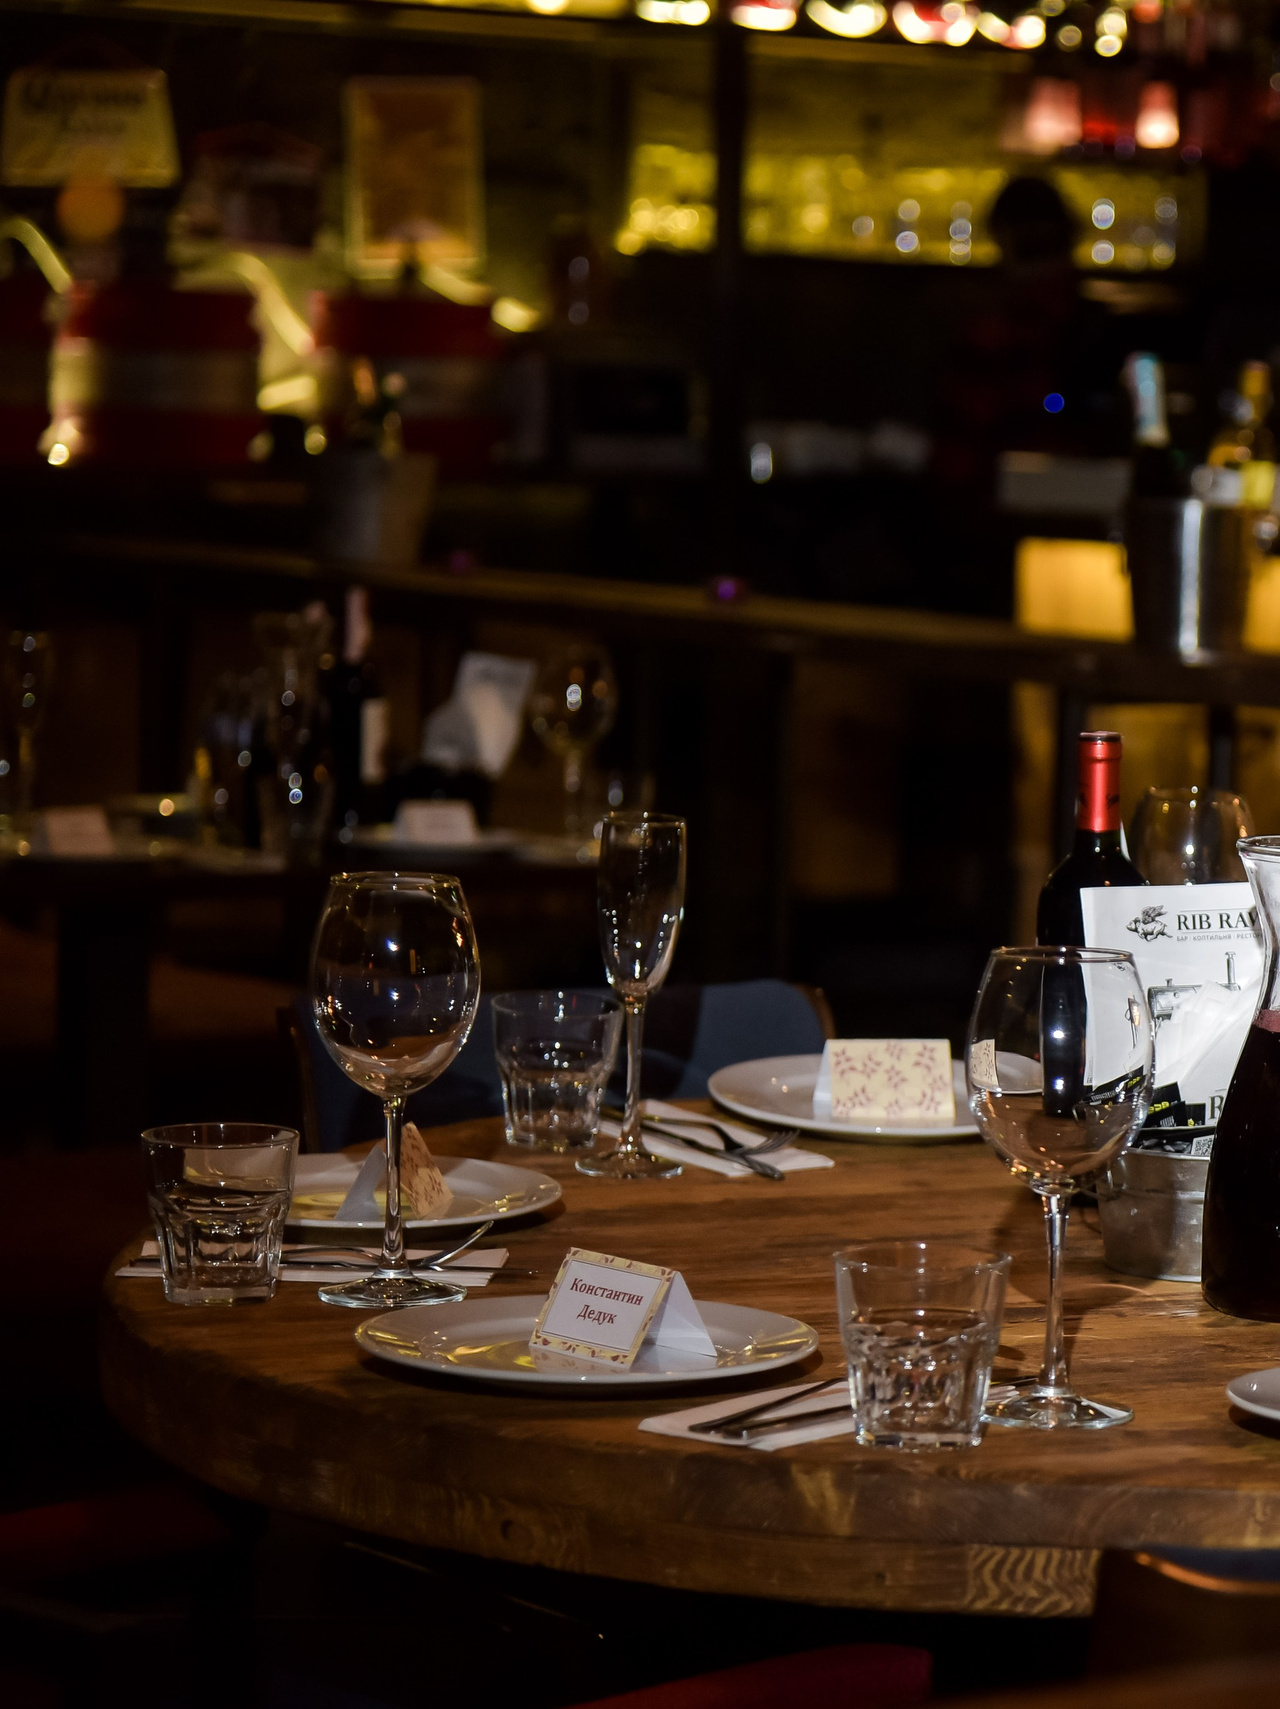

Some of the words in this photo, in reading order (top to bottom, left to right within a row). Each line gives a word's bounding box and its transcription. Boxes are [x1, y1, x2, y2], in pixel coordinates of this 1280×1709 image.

[1177, 913, 1212, 931] RIB
[1177, 934, 1188, 942] БАР
[570, 1278, 644, 1306] Константин
[576, 1304, 617, 1325] Дедук
